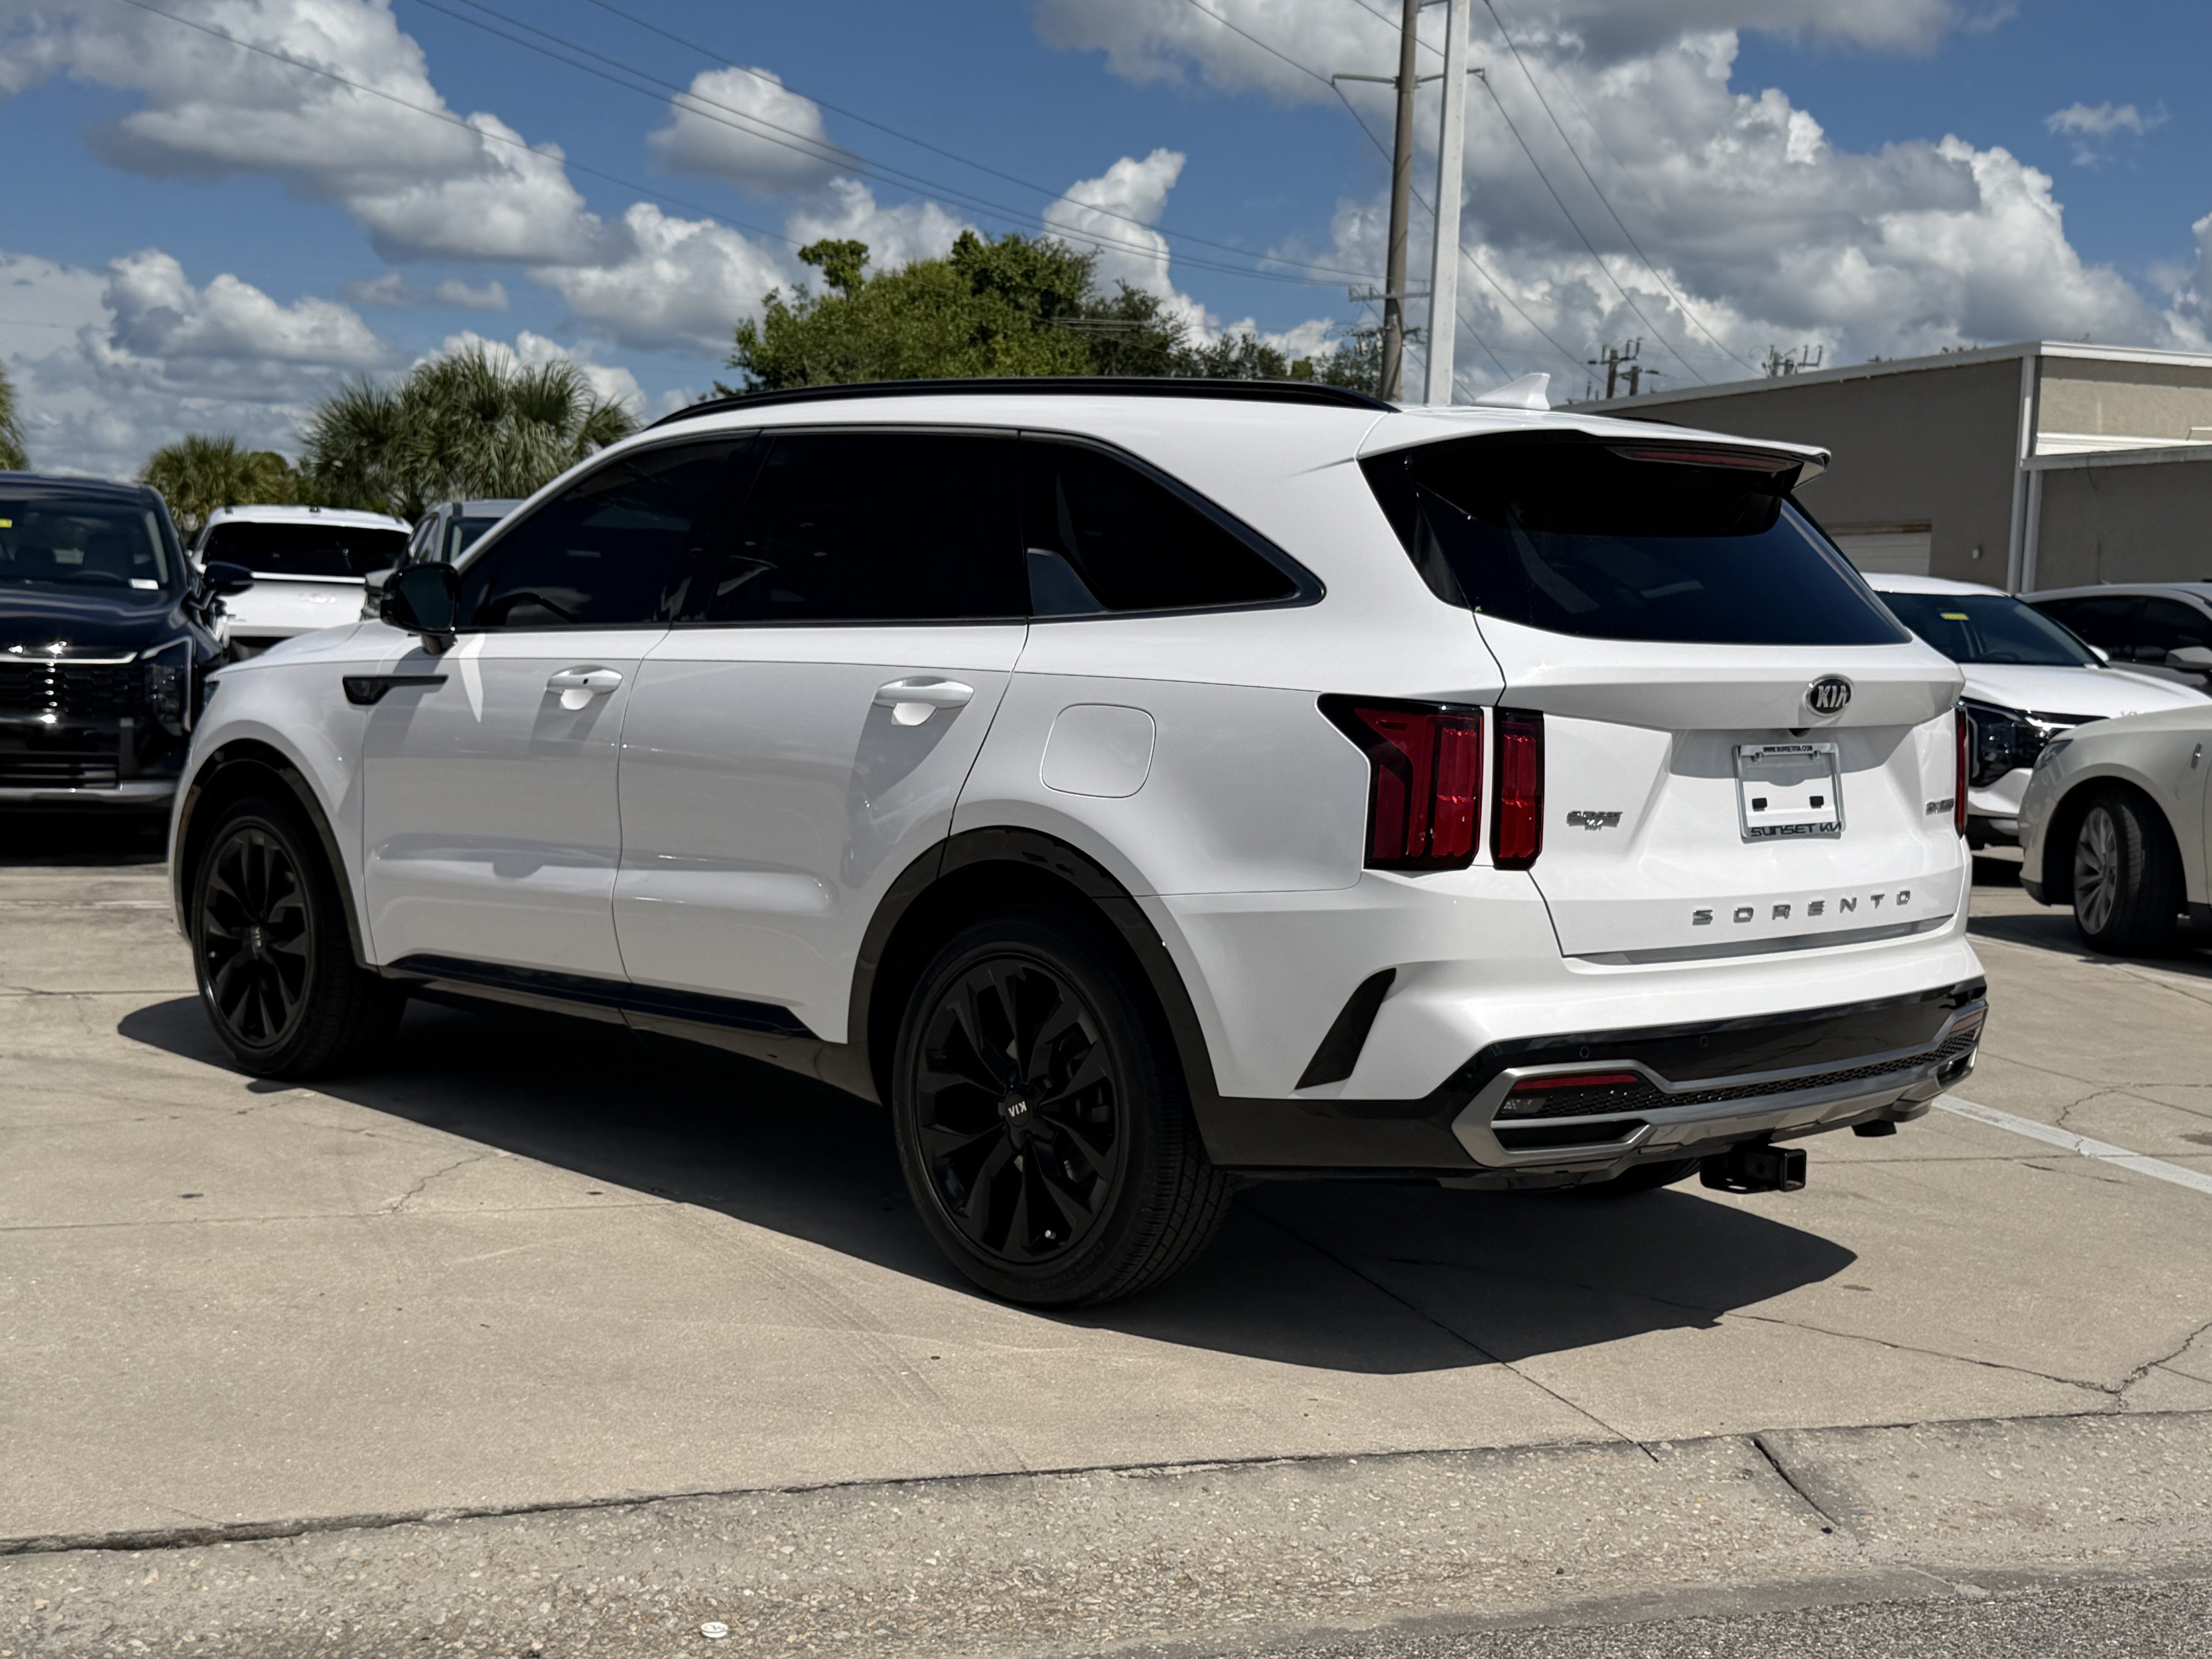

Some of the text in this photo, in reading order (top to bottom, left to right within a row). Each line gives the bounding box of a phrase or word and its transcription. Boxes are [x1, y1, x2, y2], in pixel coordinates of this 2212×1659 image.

[1816, 685, 1846, 708] KIA
[1751, 823, 1816, 837] SUNSET
[1692, 890, 1911, 926] SORENTO
[1008, 1101, 1027, 1117] KIA
